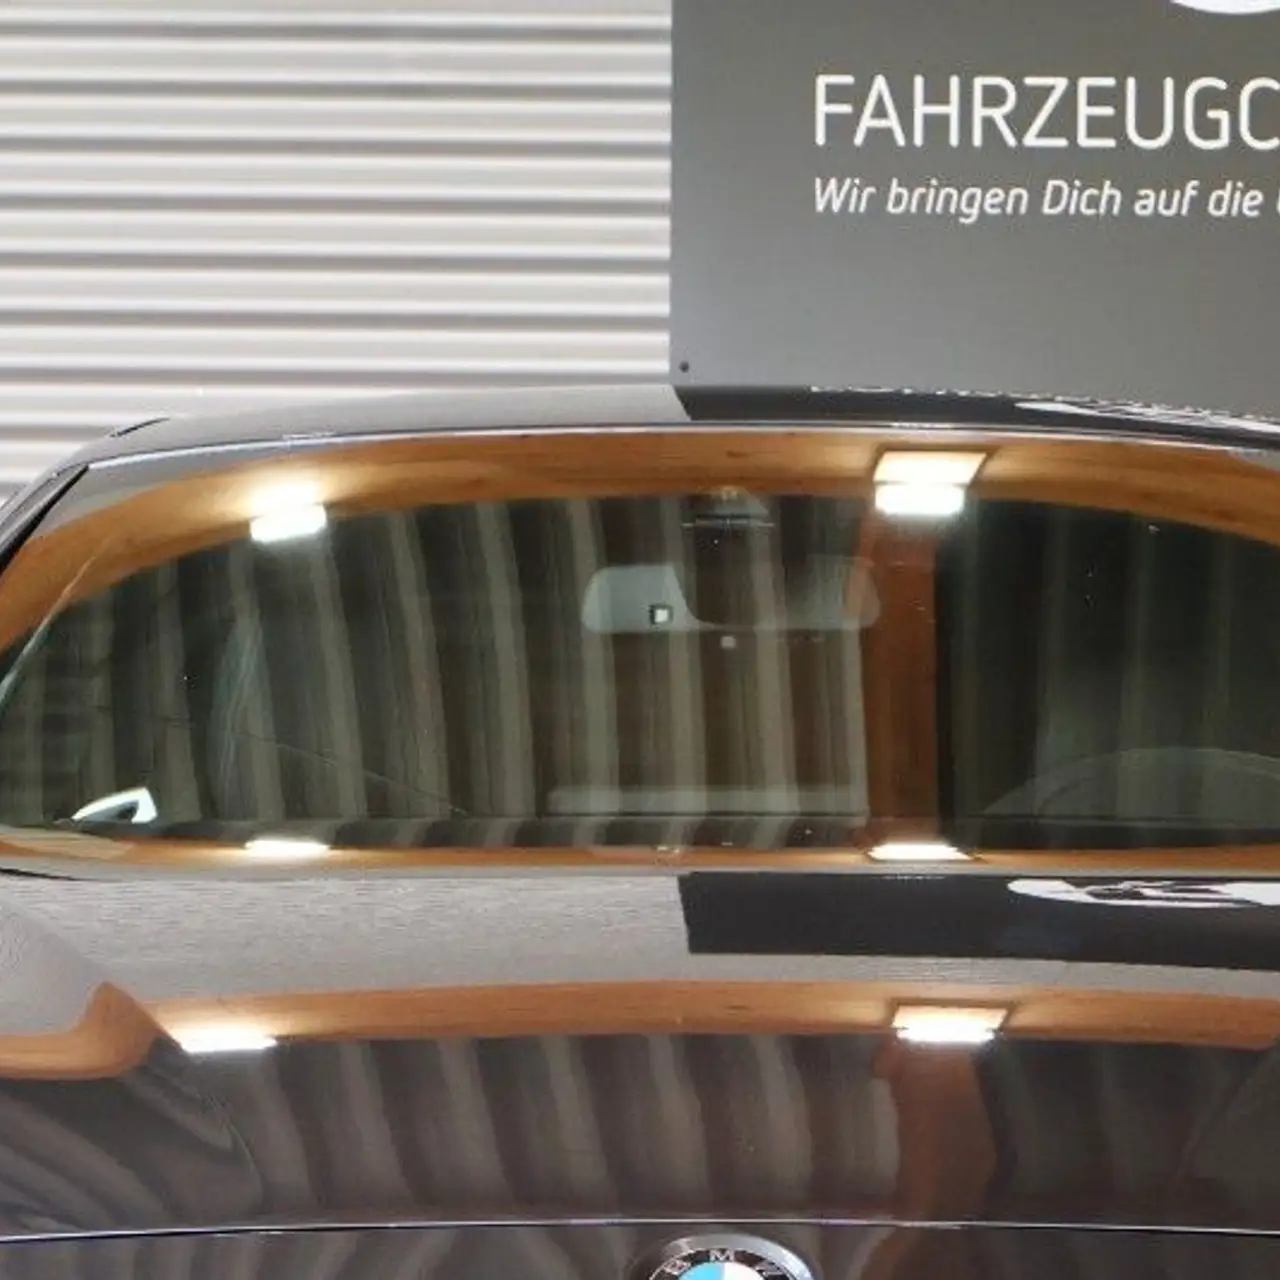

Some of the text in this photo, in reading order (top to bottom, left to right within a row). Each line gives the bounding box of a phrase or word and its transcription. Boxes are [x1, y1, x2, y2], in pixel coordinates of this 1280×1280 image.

[814, 177, 876, 213] Wir
[887, 179, 1028, 224] bringen
[1042, 180, 1121, 215] Dich
[1134, 180, 1199, 217] auf
[1207, 180, 1264, 217] die
